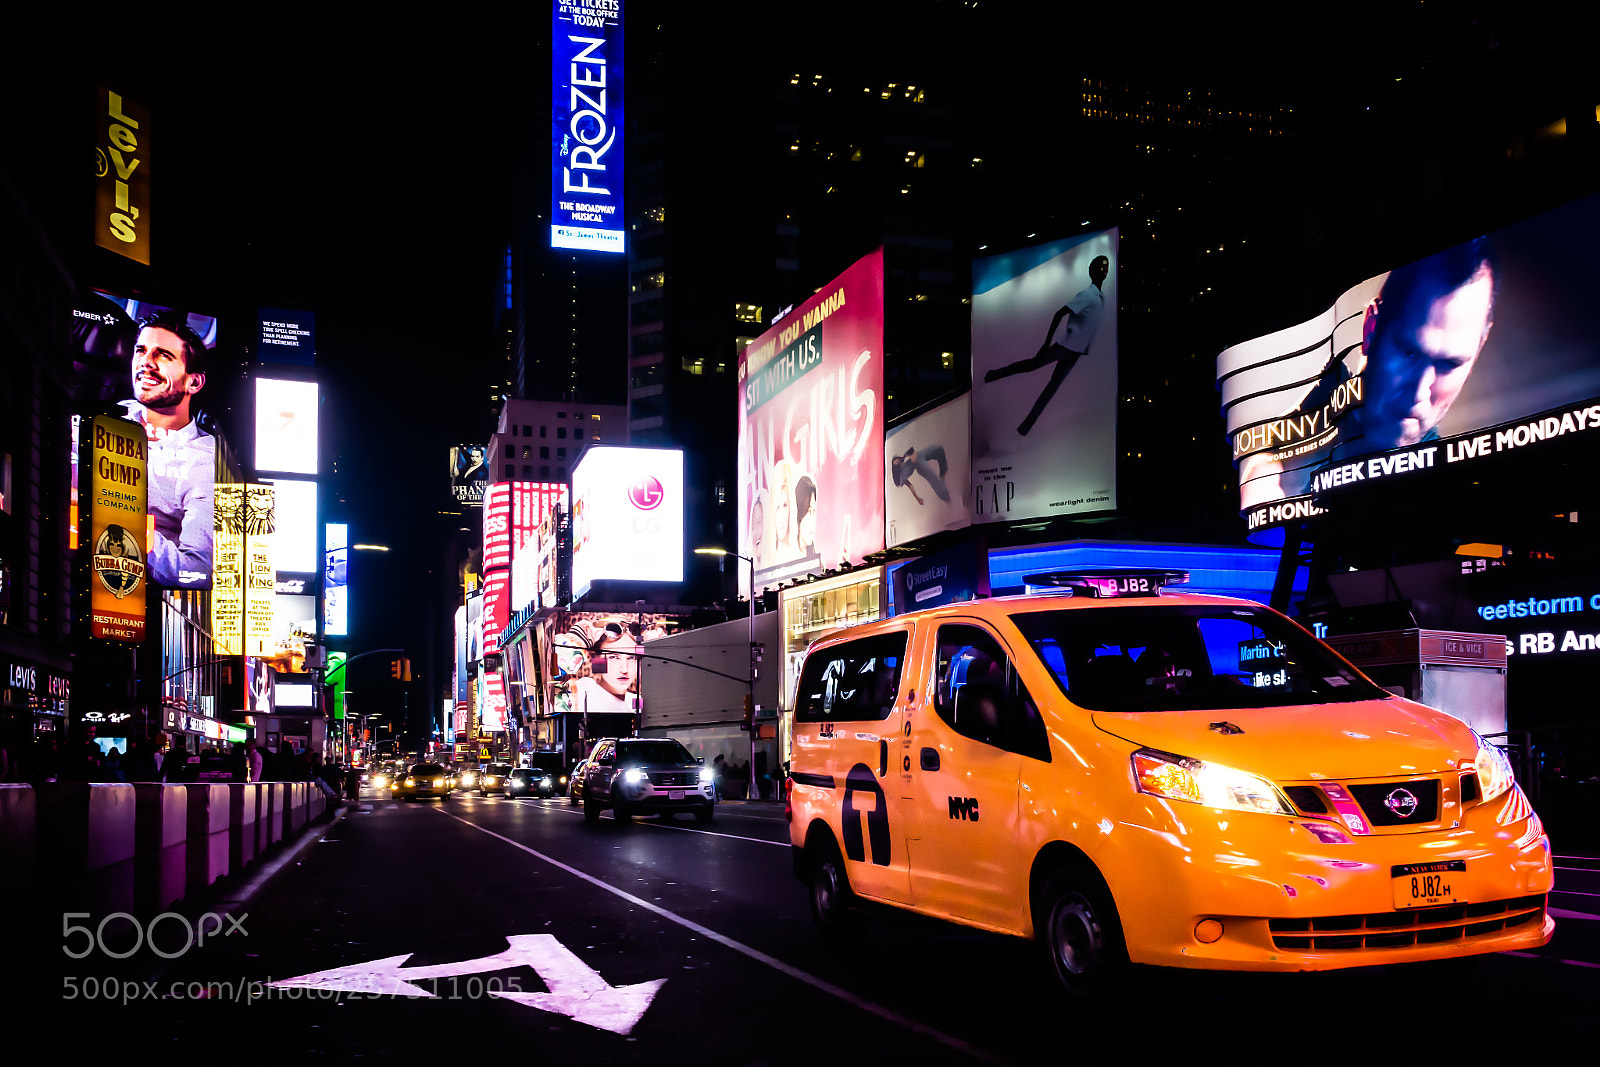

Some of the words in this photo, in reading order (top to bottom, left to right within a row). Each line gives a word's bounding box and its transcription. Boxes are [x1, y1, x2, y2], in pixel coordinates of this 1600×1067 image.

[559, 5, 567, 13] AT
[568, 6, 581, 15] THE
[581, 8, 596, 16] BOX
[596, 10, 618, 19] OFFICE
[573, 14, 605, 28] TODAY
[563, 34, 616, 195] FROZEN
[559, 200, 574, 211] THE
[575, 202, 615, 214] BROADWAY
[571, 211, 603, 222] MUSICAL
[596, 232, 618, 241] Theatre
[748, 337, 777, 374] KNOW
[779, 320, 800, 349] YOU
[803, 287, 846, 332] WANNA
[746, 377, 761, 410] SIT
[765, 350, 795, 394] WITH
[1234, 410, 1320, 456] JOHNNY
[95, 424, 144, 461] BUBBA
[1295, 441, 1317, 456] SERIES
[1320, 462, 1366, 490] WEEK
[1368, 446, 1438, 479] EVENT
[1446, 433, 1492, 464] LIVE
[1495, 404, 1600, 453] MONDAYS
[98, 456, 141, 487] GUMP
[978, 467, 998, 475] meet
[101, 488, 138, 502] SHRIMP
[976, 481, 1014, 515] GAP
[1049, 498, 1084, 508] wearlight
[1086, 495, 1109, 503] denim
[97, 497, 141, 514] COMPANY
[1248, 508, 1267, 530] LIVE
[252, 553, 268, 562] THE
[95, 556, 121, 570] BUBBA
[121, 558, 144, 576] GUMP
[250, 562, 271, 574] LION
[248, 574, 274, 588] KING
[913, 564, 948, 586] StreetEasy
[93, 614, 144, 629] RESTAURANT
[102, 626, 136, 639] MARKET
[1445, 642, 1457, 652] ICE
[1458, 642, 1465, 653] &
[1466, 643, 1483, 654] VICE
[1520, 632, 1555, 655] RB
[1240, 644, 1270, 662] Martin
[948, 795, 980, 822] NYC
[1411, 865, 1428, 874] NEW
